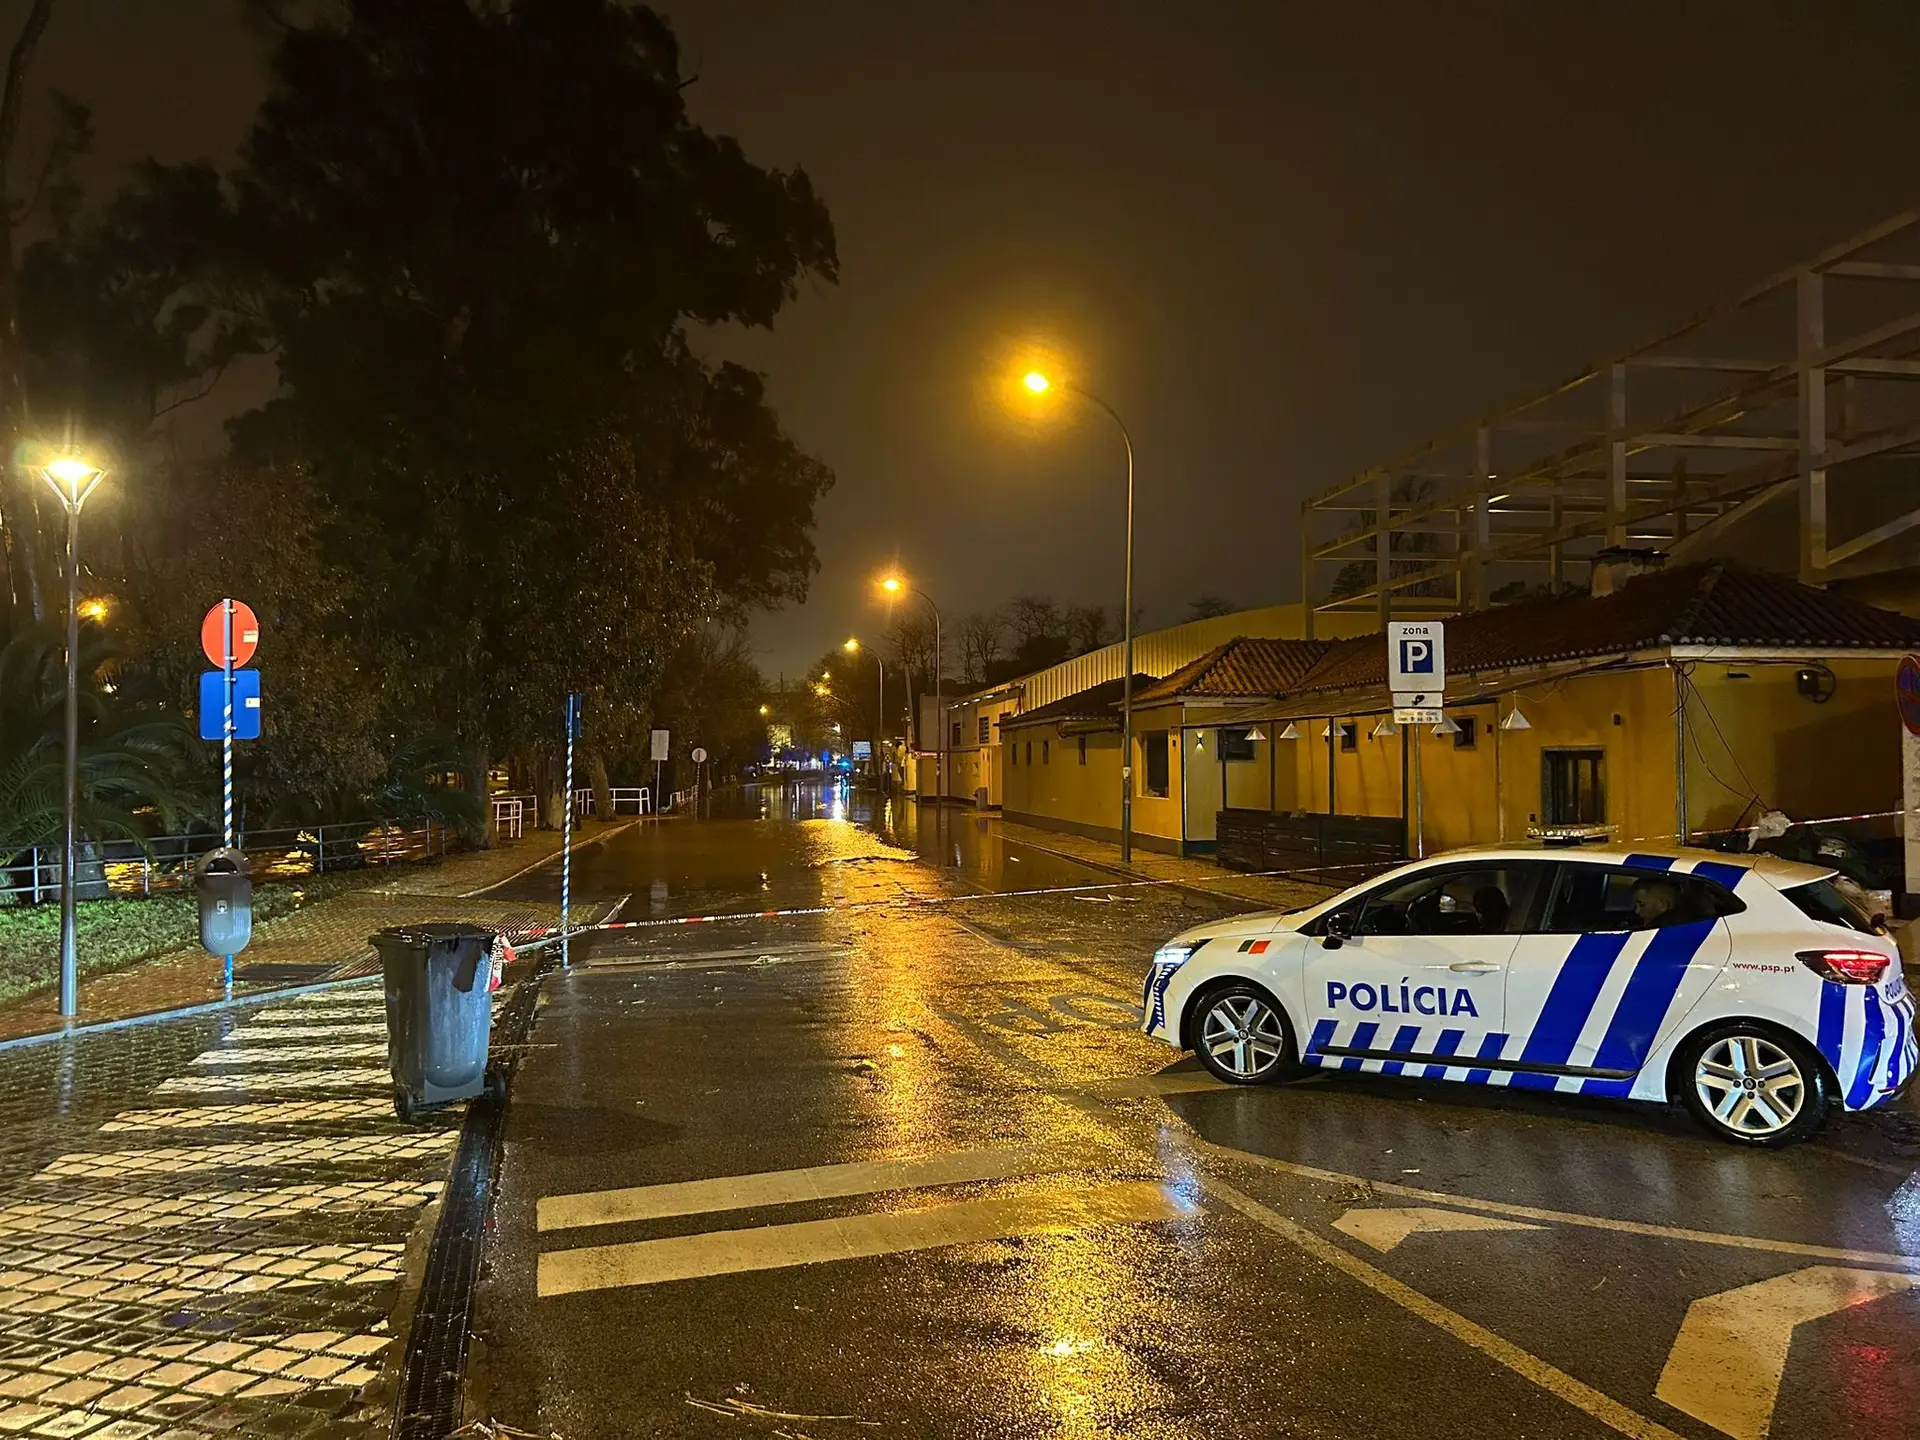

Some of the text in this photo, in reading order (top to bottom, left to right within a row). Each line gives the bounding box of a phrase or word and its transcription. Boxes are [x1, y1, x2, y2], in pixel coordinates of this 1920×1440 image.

[1402, 626, 1429, 635] zona
[1406, 641, 1428, 672] P
[1732, 962, 1795, 974] www.psp.pt
[1326, 976, 1480, 1018] POLÍCIA
